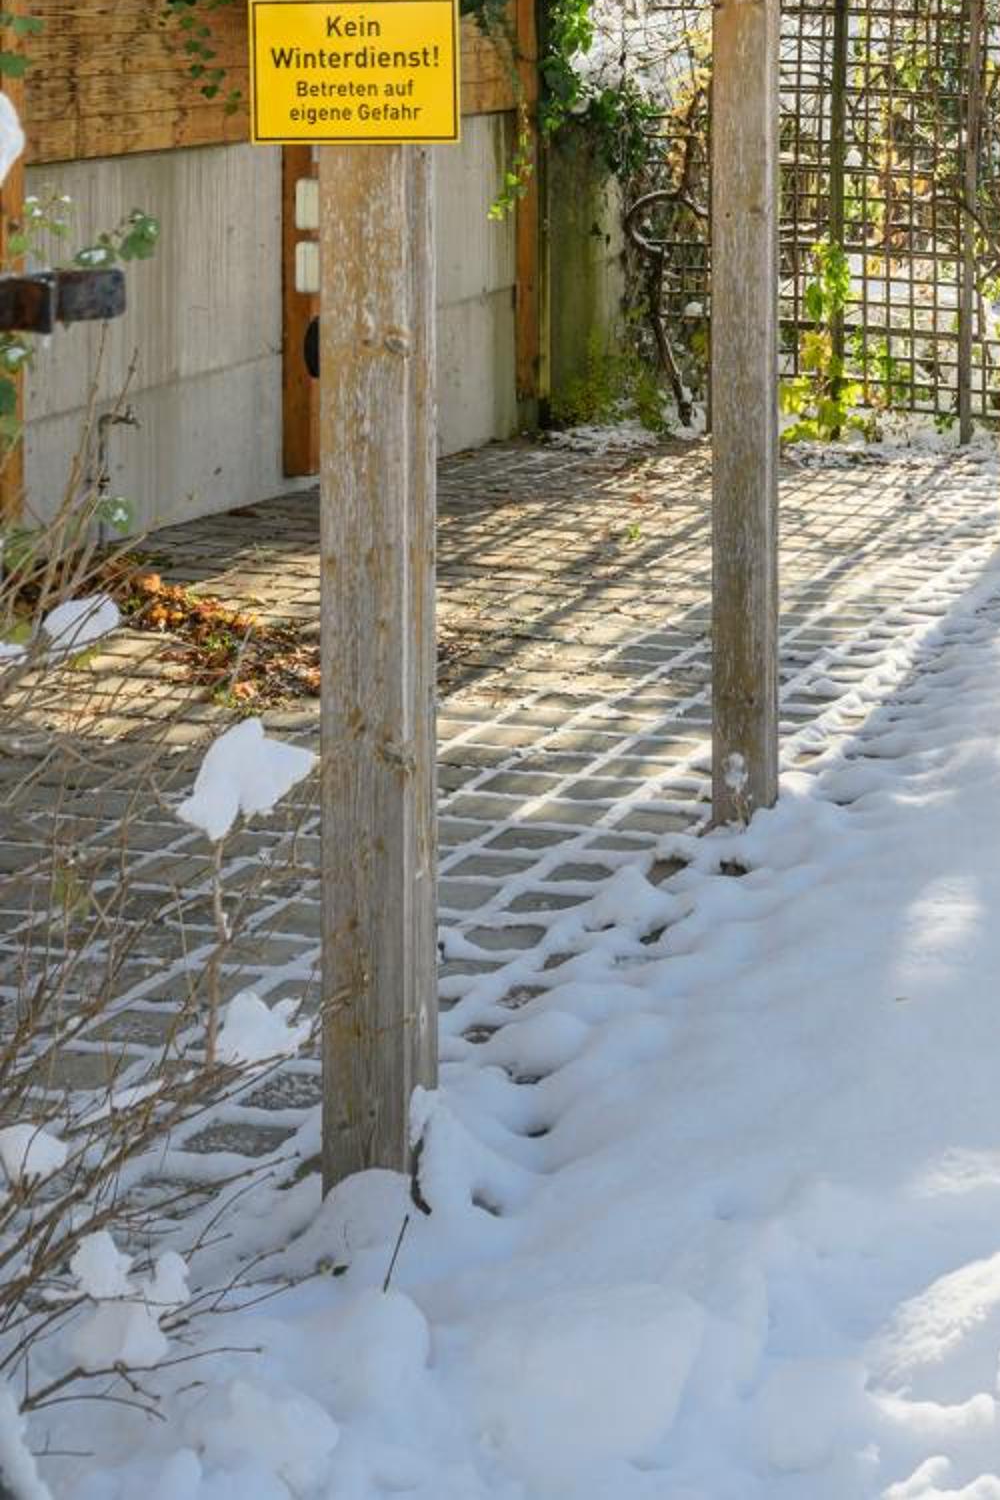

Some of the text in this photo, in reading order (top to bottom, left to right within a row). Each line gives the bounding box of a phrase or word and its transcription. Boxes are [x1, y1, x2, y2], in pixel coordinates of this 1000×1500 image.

[326, 15, 381, 37] Kein
[270, 46, 440, 69] Winterdienst!
[296, 79, 415, 97] Betreten auf
[289, 103, 422, 125] eigene Gefahr
